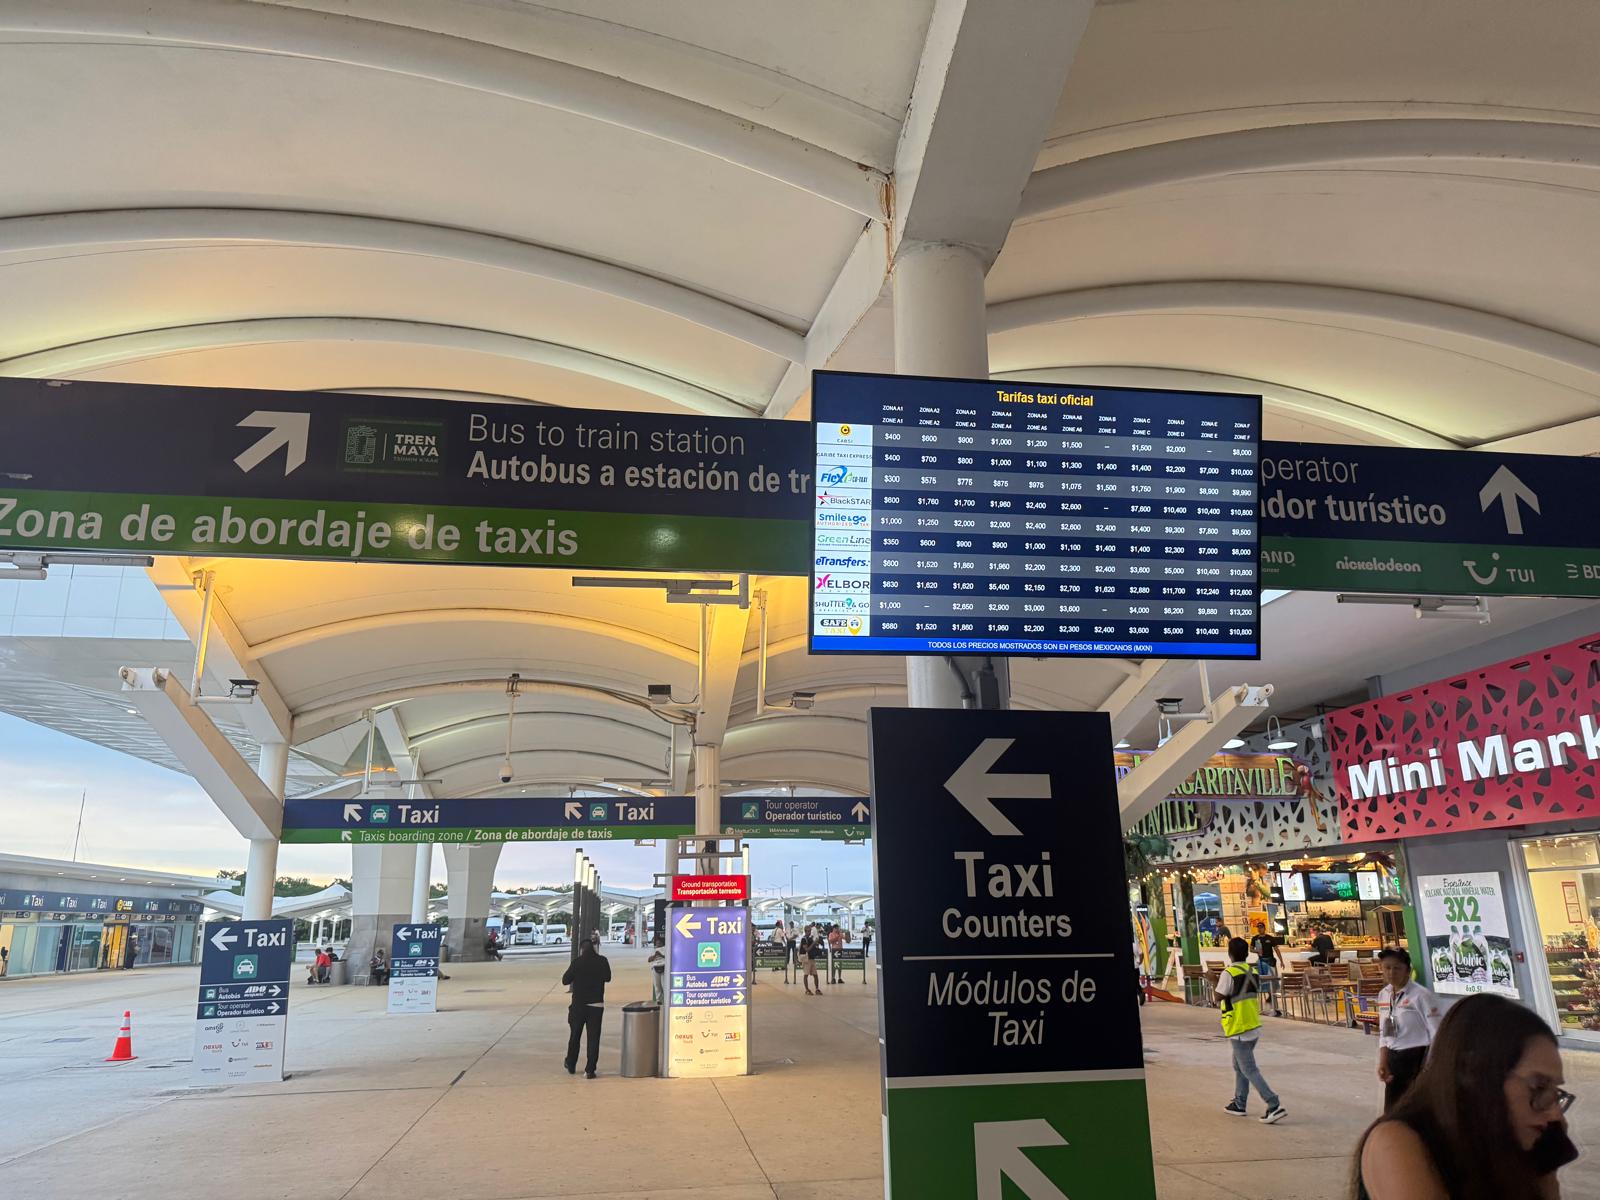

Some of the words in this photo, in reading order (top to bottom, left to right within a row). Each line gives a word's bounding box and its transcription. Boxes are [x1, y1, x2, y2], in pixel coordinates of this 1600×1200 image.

[996, 390, 1034, 404] Tarifas
[1036, 392, 1057, 405] taxi
[1060, 394, 1094, 407] oficial
[395, 433, 437, 446] TREN
[468, 413, 525, 446] Bus
[536, 418, 566, 448] to
[575, 421, 640, 451] train
[650, 426, 745, 456] station
[393, 445, 439, 457] MAYA
[991, 438, 1012, 446] $1,000
[1062, 441, 1083, 449] $1,500
[1132, 444, 1152, 452] $1,500
[1166, 445, 1186, 453] $2,000
[466, 450, 592, 486] Autobus
[600, 465, 616, 487] a
[624, 461, 740, 492] estación
[748, 464, 781, 493] de
[788, 468, 811, 494] tr
[921, 455, 937, 463] $700
[990, 458, 1012, 466] $1,000
[1026, 460, 1047, 468] $1,100
[1061, 461, 1083, 469] $1,300
[1096, 463, 1117, 471] $1,400
[1131, 464, 1152, 472] $1,400
[1165, 465, 1186, 473] $2,200
[1199, 467, 1219, 475] $7,000
[1230, 468, 1254, 476] $10,000
[1261, 456, 1359, 487] perator
[884, 475, 900, 483] $300
[1096, 484, 1117, 492] $1,500
[954, 499, 976, 507] $1,700
[1025, 501, 1047, 509] $2,400
[1197, 507, 1221, 515] $10,400
[1324, 493, 1447, 526] turístico
[0, 498, 103, 541] Zona
[120, 503, 176, 542] de
[191, 506, 392, 557] abordaje
[408, 513, 461, 552] de
[475, 519, 579, 557] taxis
[881, 517, 902, 525] $1,000
[990, 521, 1011, 529] $2,000
[1025, 522, 1046, 530] $2,400
[1096, 524, 1116, 532] $2,400
[1130, 525, 1151, 533] $4,400
[1025, 542, 1046, 550] $1,000
[1060, 543, 1081, 551] $1,100
[1095, 544, 1116, 552] $1,400
[1130, 545, 1151, 553] $1,400
[1164, 546, 1185, 554] $2,300
[1198, 547, 1219, 555] $7,000
[1060, 564, 1081, 572] $2,300
[1095, 565, 1116, 573] $2,400
[1164, 567, 1184, 575] $5,000
[1335, 556, 1422, 573] nickelodeon
[1506, 568, 1535, 583] TUI
[988, 583, 1010, 591] $5,400
[1024, 584, 1045, 592] $2,150
[1059, 585, 1081, 593] $2,700
[1162, 587, 1186, 595] $11,700
[1129, 606, 1150, 614] $4,000
[1229, 608, 1254, 616] $13,200
[916, 623, 937, 631] $1,520
[1024, 625, 1045, 633] $2,200
[1059, 625, 1080, 634] $2,300
[1094, 626, 1115, 634] $2,400
[1163, 627, 1184, 635] $5,000
[1196, 628, 1219, 636] $10,400
[927, 641, 952, 649] TODOS
[953, 641, 967, 649] LOS
[999, 642, 1042, 650] MOSTRADOS
[1069, 643, 1093, 651] PESOS
[1133, 644, 1153, 653] (MXN)
[1347, 747, 1445, 800] Mini
[615, 802, 655, 822] Taxi
[765, 799, 782, 810] Tour
[784, 800, 819, 812] operator
[398, 804, 440, 824] Taxi
[765, 810, 805, 822] Operador
[807, 810, 842, 821] turístico
[360, 830, 385, 841] Taxis
[388, 830, 435, 843] boarding
[438, 831, 463, 841] zone
[474, 829, 502, 841] Zona
[505, 829, 519, 841] de
[521, 828, 568, 842] abordaje
[571, 828, 585, 839] de
[587, 828, 612, 839] taxis
[954, 851, 1054, 898] Taxi
[702, 880, 738, 888] transportation
[677, 888, 718, 896] Transportación
[1424, 887, 1442, 898] VOLCANIC
[1442, 887, 1461, 896] NATURAL
[1461, 886, 1480, 896] MINERAL
[1480, 886, 1496, 896] WATER
[31, 895, 45, 907] Taxi
[66, 896, 79, 908] Taxi
[97, 898, 108, 909] Taxi
[150, 901, 159, 911] Taxi
[1443, 896, 1482, 922] 3X2
[706, 916, 742, 936] Taxi
[941, 907, 1073, 939] Counters
[244, 927, 286, 948] Taxi
[414, 927, 438, 939] Taxi
[927, 969, 1052, 1007] Módulos
[1061, 969, 1097, 1004] de
[218, 992, 241, 1000] Autobús
[216, 1009, 242, 1017] Operador
[987, 1010, 1045, 1047] Taxi
